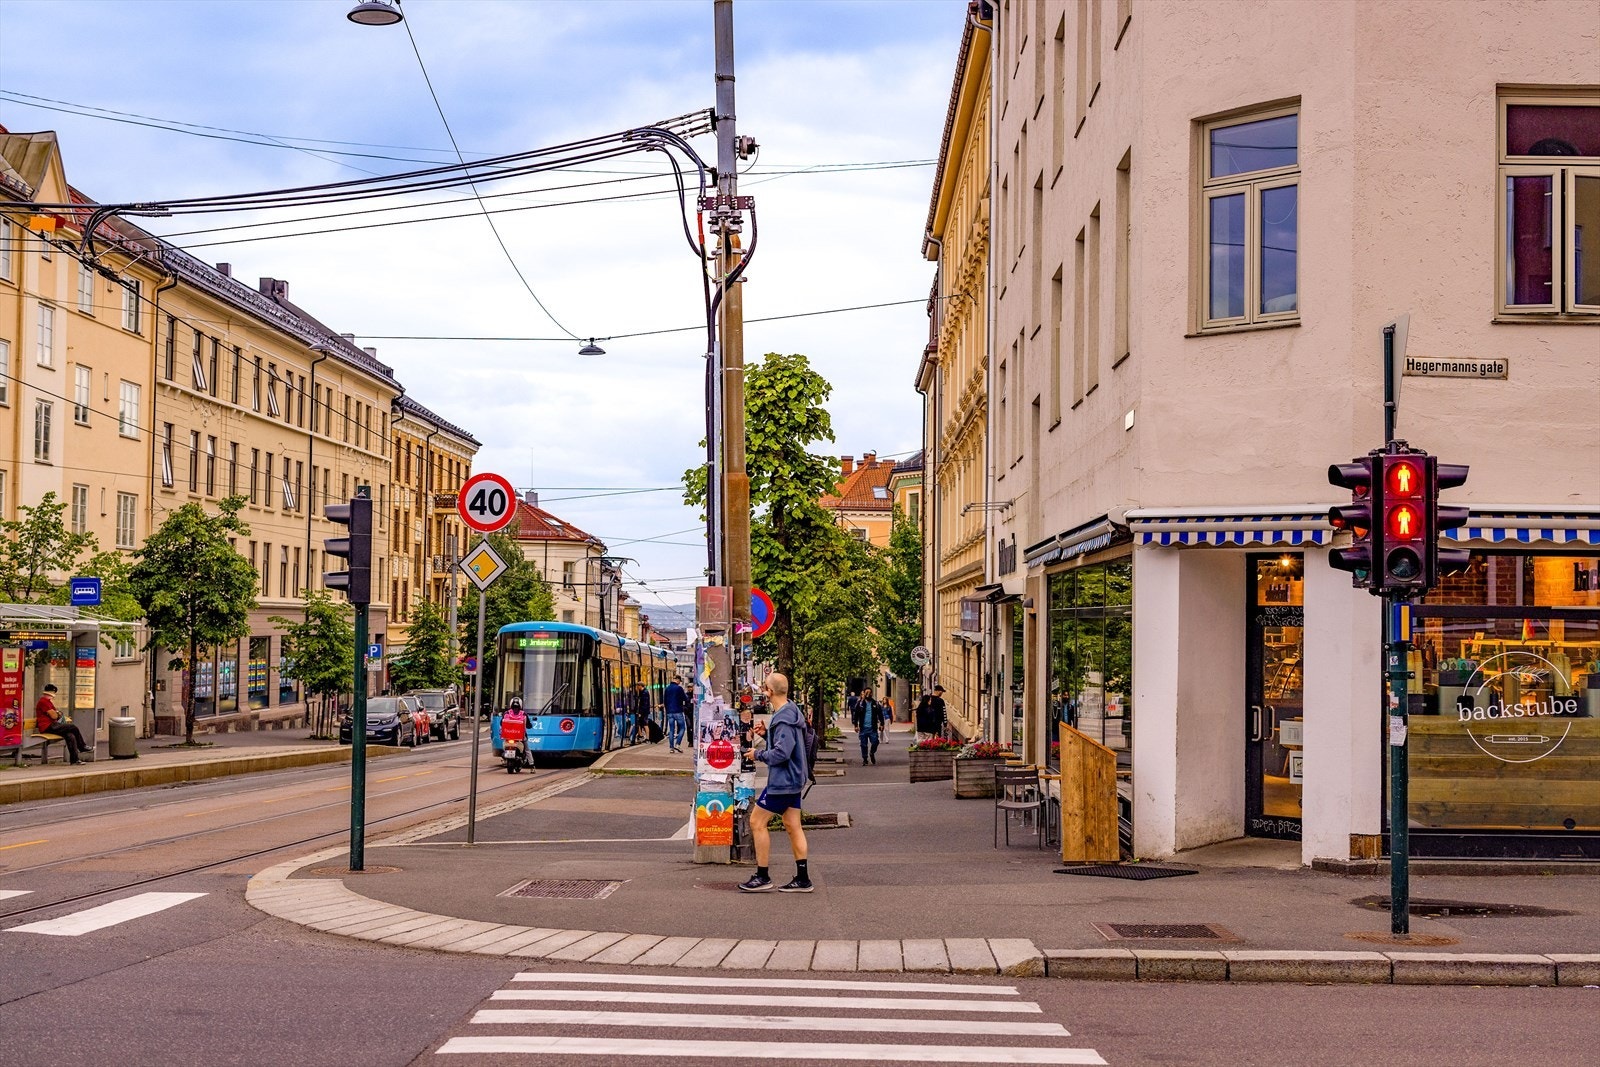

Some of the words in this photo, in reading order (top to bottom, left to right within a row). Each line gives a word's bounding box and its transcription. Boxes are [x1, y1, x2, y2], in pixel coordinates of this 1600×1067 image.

[1406, 358, 1477, 374] Hegermanns
[1480, 360, 1503, 376] gate
[469, 488, 506, 516] 40
[370, 646, 378, 657] P
[1457, 695, 1578, 722] backstube
